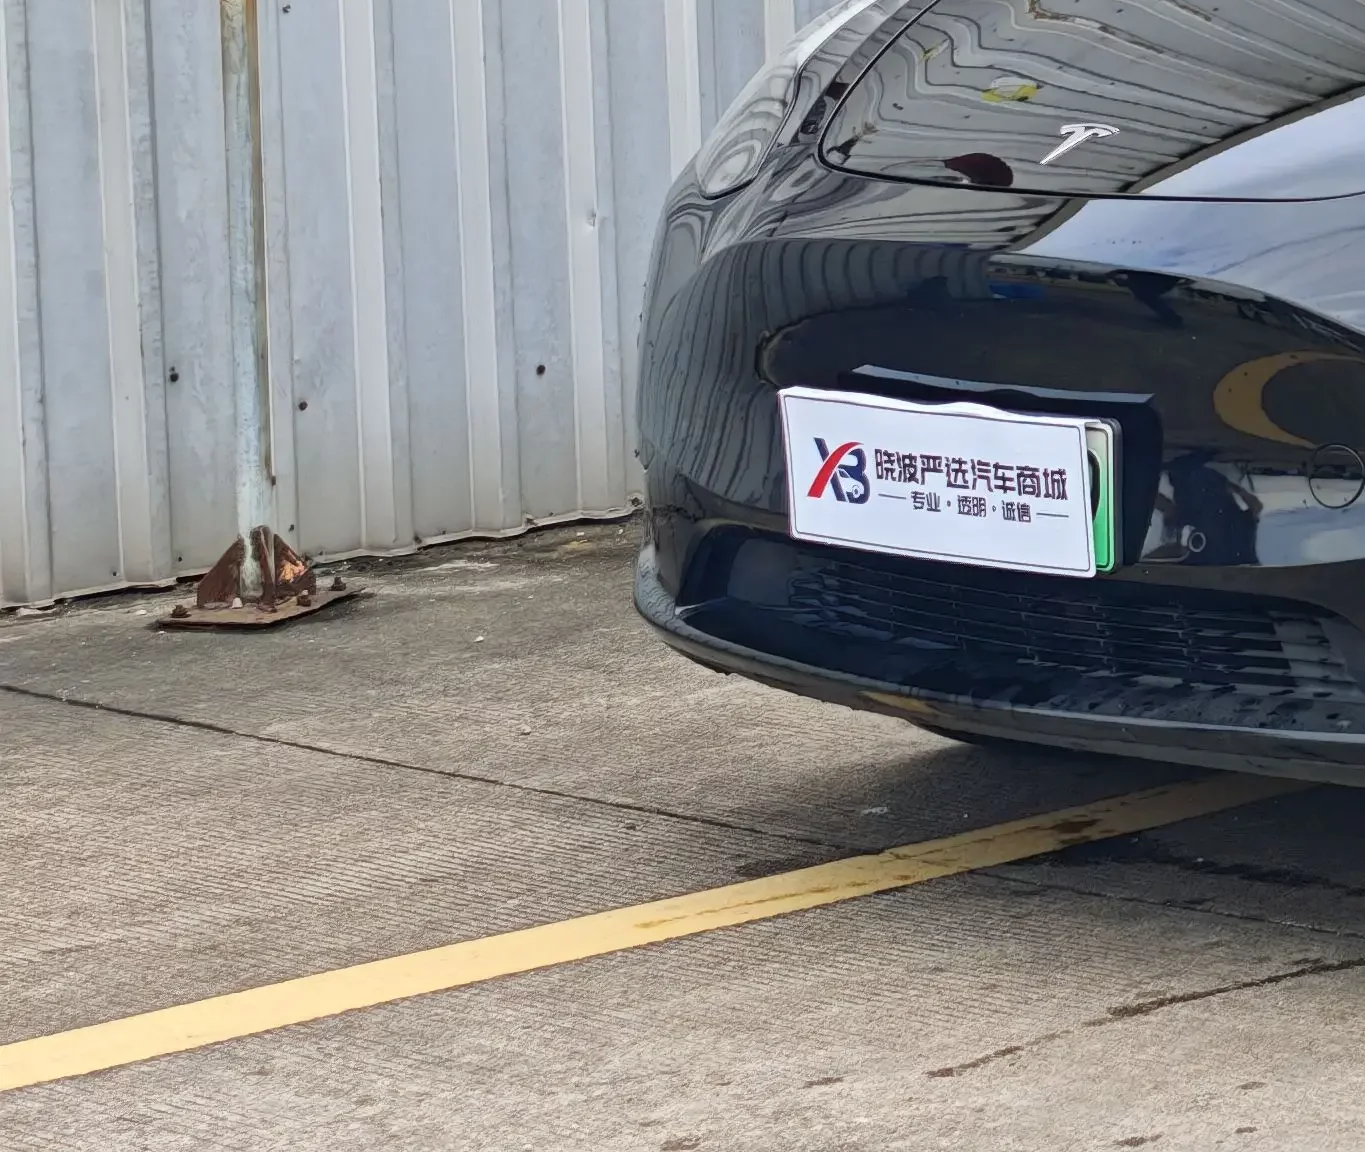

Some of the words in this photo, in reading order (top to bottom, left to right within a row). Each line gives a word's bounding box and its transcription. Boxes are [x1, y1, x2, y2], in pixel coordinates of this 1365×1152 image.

[874, 448, 1069, 501] 晓波严选汽车商城
